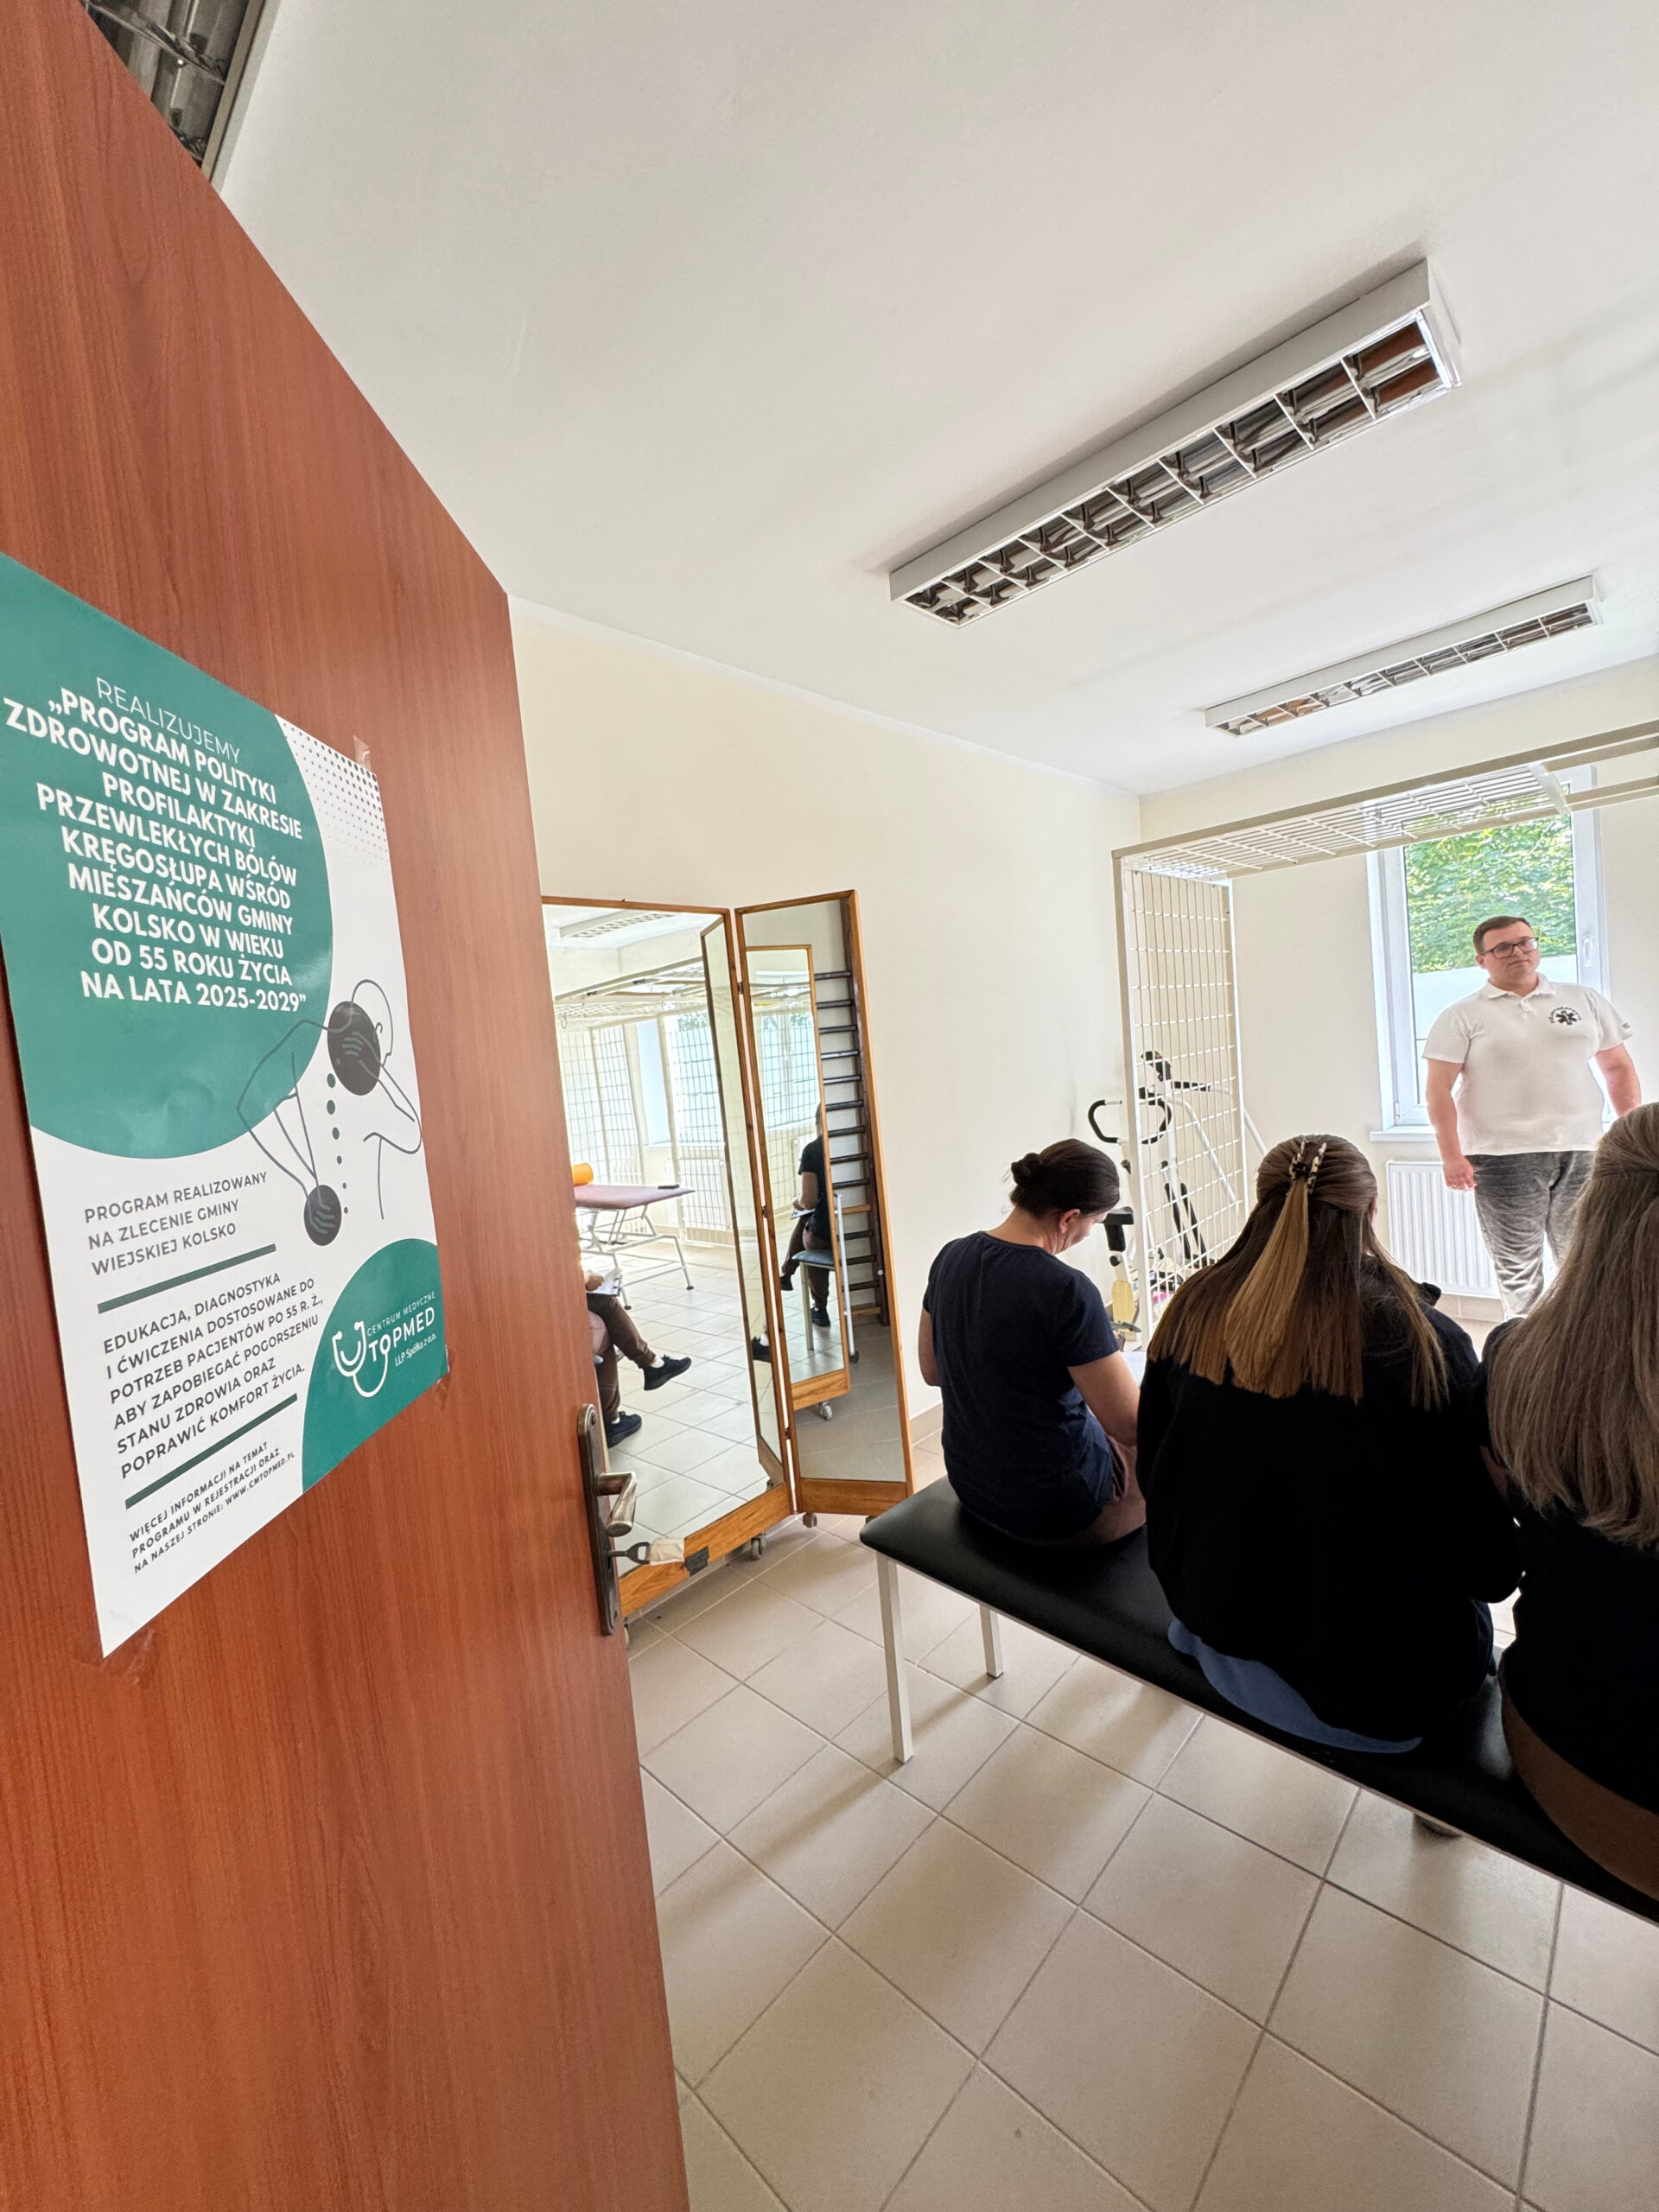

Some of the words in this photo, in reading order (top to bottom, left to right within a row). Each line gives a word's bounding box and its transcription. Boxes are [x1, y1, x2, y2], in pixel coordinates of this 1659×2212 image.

[48, 687, 190, 767] „PROGRAM
[194, 748, 276, 804] POLITYKI
[96, 677, 240, 764] REALIZUJEMY
[3, 697, 191, 796] ZDROWOTNEJ
[195, 778, 216, 805] W
[221, 789, 302, 840] ZAKRESIE
[103, 772, 255, 848] PROFILAKTYKI
[36, 782, 231, 867] PRZEWLEKŁYCH
[234, 848, 296, 887] BÓLÓW
[61, 825, 223, 893] KRĘGOSŁUPA
[226, 873, 291, 909] WŚRÓD
[68, 862, 232, 923] MIESZAŃCÓW
[238, 905, 293, 935] GMINY
[92, 903, 195, 944] KOLSKO
[199, 924, 220, 948] W
[225, 929, 283, 959] WIEKU
[80, 970, 124, 1000] NA
[129, 976, 192, 1004] LATA
[195, 982, 307, 1012] 2025-2029”
[92, 938, 131, 966] OD
[139, 944, 168, 971] 55
[172, 950, 234, 979] ROKU
[238, 953, 293, 986] ŻYCIA
[85, 1192, 168, 1224] PROGRAM
[174, 1172, 268, 1203] REALIZOWANY
[88, 1231, 114, 1250] NA
[118, 1211, 194, 1242] ZLECENIE
[197, 1199, 238, 1221] GMINY
[92, 1239, 177, 1275] WIEJSKIEJ
[182, 1223, 236, 1249] KOLSKO
[104, 1310, 191, 1354] EDUKACJA,
[194, 1273, 281, 1316] DIAGNOSTYKA
[106, 1365, 111, 1379] I
[118, 1326, 203, 1374] ĆWICZENIA
[207, 1285, 297, 1334] DOSTOSOWANE
[299, 1278, 315, 1294] DO
[110, 1359, 183, 1404] POTRZEB
[187, 1319, 264, 1366] PACJENTÓW
[268, 1312, 283, 1327] PO
[286, 1306, 297, 1319] 55
[300, 1300, 309, 1312] R.
[366, 1311, 401, 1337] CENTRUM
[403, 1291, 435, 1314] MEDYCZNE
[368, 1306, 435, 1362] TOPMED
[114, 1401, 146, 1430] ABY
[151, 1351, 241, 1409] ZAPOBIEGAĆ
[244, 1314, 318, 1362] POGORSZENIU
[394, 1352, 405, 1366] LLP
[117, 1414, 170, 1454] STANU
[175, 1377, 241, 1421] ZDROWIA
[244, 1357, 276, 1382] ORAZ
[121, 1416, 207, 1479] POPRAWIĆ
[210, 1382, 269, 1427] KOMFORT
[271, 1363, 305, 1389] ŻYCIA.
[130, 1510, 168, 1541] WIĘCEJ
[170, 1470, 226, 1514] INFORMACJI
[229, 1461, 240, 1474] NA
[243, 1441, 268, 1465] TEMAT
[132, 1511, 190, 1559] PROGRAMU
[193, 1503, 201, 1514] W
[204, 1464, 256, 1507] REJESTRACJI
[258, 1447, 280, 1467] ORAZ
[134, 1559, 148, 1573] NA
[150, 1531, 184, 1561] NASZEJ
[187, 1504, 224, 1535] STRONIE:
[225, 1452, 295, 1505] WWW.CMTOPMED.PL
